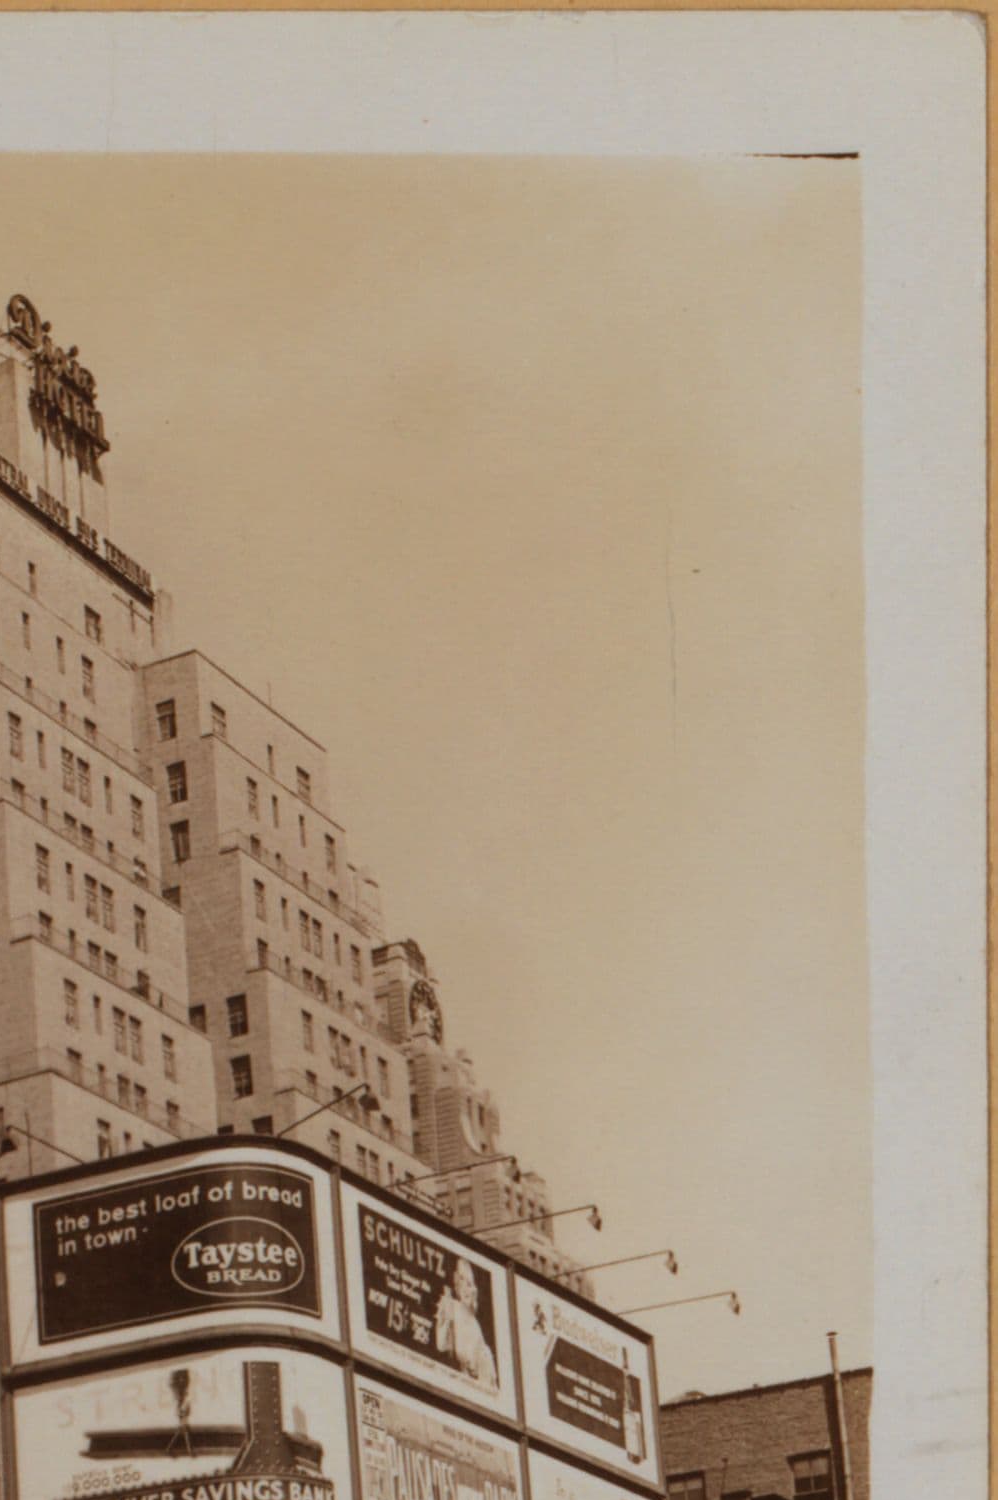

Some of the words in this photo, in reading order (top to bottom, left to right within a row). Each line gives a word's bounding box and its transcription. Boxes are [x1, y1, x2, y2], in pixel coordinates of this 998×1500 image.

[55, 1213, 90, 1236] the
[98, 1201, 147, 1226] best
[155, 1181, 200, 1212] loaf
[208, 1176, 233, 1202] of
[242, 1180, 303, 1209] bread
[57, 1238, 77, 1257] in
[85, 1227, 138, 1251] town
[183, 1236, 299, 1270] Taystee
[364, 1214, 446, 1279] SCHULTZ
[207, 1268, 282, 1286] BREAD
